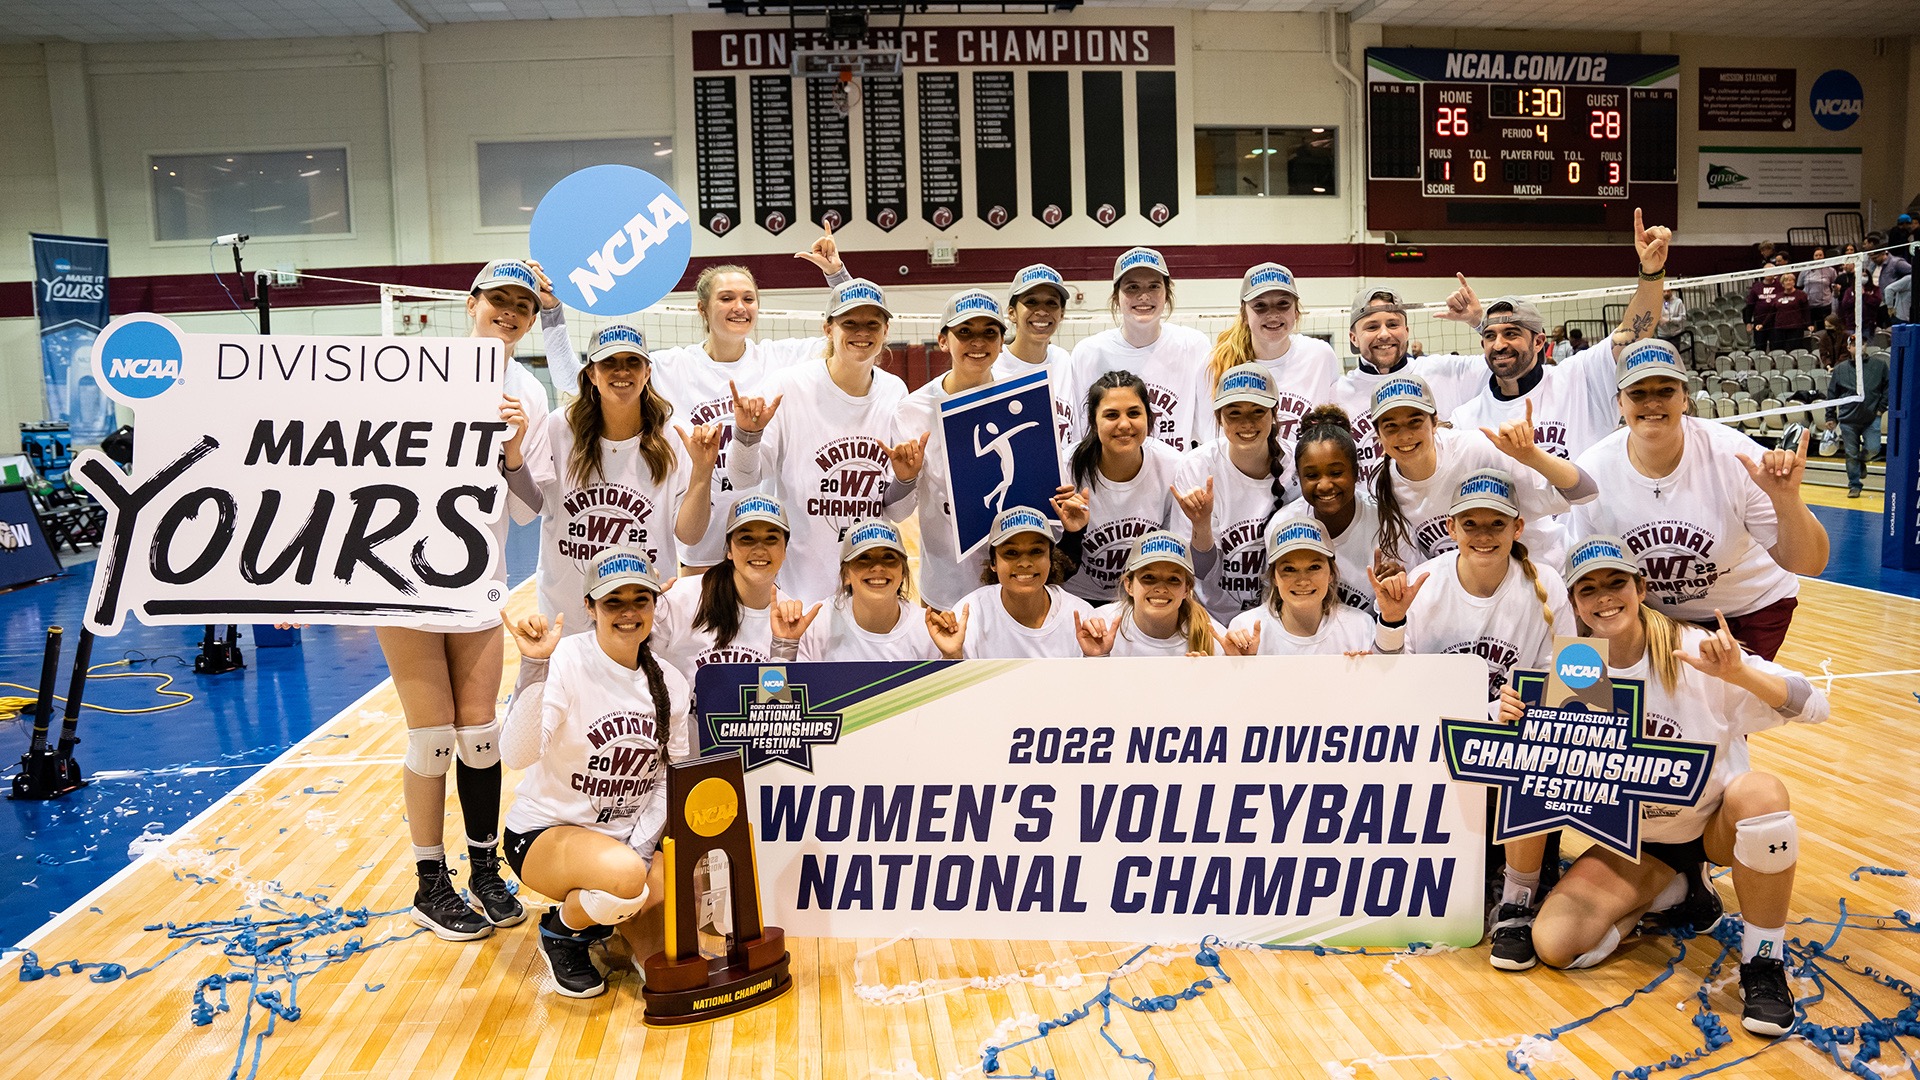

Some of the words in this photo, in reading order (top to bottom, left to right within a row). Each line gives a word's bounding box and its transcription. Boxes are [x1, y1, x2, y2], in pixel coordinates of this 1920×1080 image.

[720, 30, 940, 67] CONCE
[957, 29, 1149, 63] CHAMPIONS
[1445, 53, 1608, 82] NCAA.COM/D2
[1719, 73, 1744, 82] MISSION
[1745, 73, 1778, 82] STATEMENT
[1440, 91, 1473, 104] HOME
[1518, 88, 1562, 117] 1:30
[1586, 94, 1619, 107] GUEST
[1815, 99, 1863, 116] NCAA
[1437, 107, 1469, 136] 26
[1590, 111, 1620, 139] 28
[1502, 128, 1533, 139] PERIOD
[1536, 124, 1548, 143] 4
[1429, 149, 1452, 159] FOULS
[1469, 149, 1491, 160] T.O.L.
[1500, 150, 1532, 160] PLAYER
[1534, 150, 1556, 161] FOUL
[1563, 151, 1585, 161] T.O.L.
[1600, 152, 1623, 162] FOULS
[1444, 161, 1451, 181] 1
[1473, 160, 1487, 183] 0
[1568, 162, 1581, 184] 0
[1609, 163, 1620, 184] 3
[1709, 172, 1739, 185] gnac
[1427, 184, 1456, 194] SCORE
[1513, 184, 1542, 195] MATCH
[1597, 186, 1625, 196] SCORE
[568, 192, 689, 308] NCAA
[1121, 254, 1160, 271] CHAMPIONS
[65, 274, 94, 284] MAKE
[95, 276, 105, 284] IT
[1250, 270, 1291, 287] CHAMPIONS
[41, 276, 105, 302] YOURS
[955, 297, 999, 314] CHAMPIONS
[599, 326, 643, 347] CHAMPIONS
[109, 358, 180, 380] NCAA
[218, 343, 450, 382] DIVISION
[475, 346, 496, 382] II
[1626, 350, 1675, 370] CHAMPIONS
[1223, 375, 1267, 391] CHAMPIONS
[1375, 381, 1423, 404] CHAMPIONS
[1160, 420, 1175, 433] 22
[245, 419, 432, 467] MAKE
[446, 422, 507, 467] IT
[815, 441, 890, 472] NATIONA
[820, 478, 839, 493] 20
[840, 469, 883, 497] WT
[1460, 480, 1509, 498] CHAMPIONS
[563, 488, 653, 525] NATIONAL
[734, 502, 781, 518] CHAMPIONS
[807, 498, 883, 518] CHAMPIO
[80, 435, 498, 626] YOURS
[568, 522, 586, 537] 20
[587, 515, 635, 545] WT
[629, 529, 648, 543] 22
[1000, 515, 1045, 532] CHAMPIONS
[851, 526, 897, 546] CHAMPIONS
[1082, 522, 1157, 554] NATION
[1221, 522, 1266, 556] NATIO
[1277, 527, 1322, 546] CHAMPIONS
[1627, 526, 1715, 559] ATIONAL
[1141, 540, 1186, 558] CHAMPIONS
[1572, 545, 1623, 568] CHAMPIONS
[598, 558, 648, 578] CHAMPIONS
[1087, 556, 1105, 568] 20
[1223, 560, 1240, 573] 20
[1645, 555, 1697, 580] WT
[1694, 562, 1717, 575] 22
[1559, 663, 1601, 679] NCAA
[764, 680, 785, 688] NCAA
[749, 710, 802, 722] NATIONAL
[1526, 708, 1557, 720] 2022
[1559, 710, 1611, 725] DIVISION
[1613, 716, 1629, 727] II
[587, 716, 660, 750] NATION
[720, 721, 833, 738] CHAMPIONSHIPS
[1522, 720, 1628, 751] NATIONAL
[752, 737, 802, 749] FESTIVAL
[1008, 727, 1116, 764] 2022
[1126, 726, 1228, 764] NCAA
[1241, 725, 1419, 763] DIVISION
[1429, 725, 1445, 763] I
[588, 755, 611, 772] 20
[610, 747, 659, 776] WT
[1461, 739, 1692, 788] CHAMPIONSHIPS
[571, 773, 656, 797] CHAMPION
[1520, 775, 1620, 806] FESTIVAL
[692, 801, 738, 827] NCAA
[760, 784, 1056, 842] WOMEN'S
[1080, 783, 1452, 845] VOLLEYBALL
[1544, 800, 1594, 815] SEATTLE
[796, 854, 1087, 913] NATIONAL
[1110, 855, 1456, 918] CHAMPION
[693, 989, 733, 1011] NATIONAL
[734, 977, 773, 1001] CHAMPION
